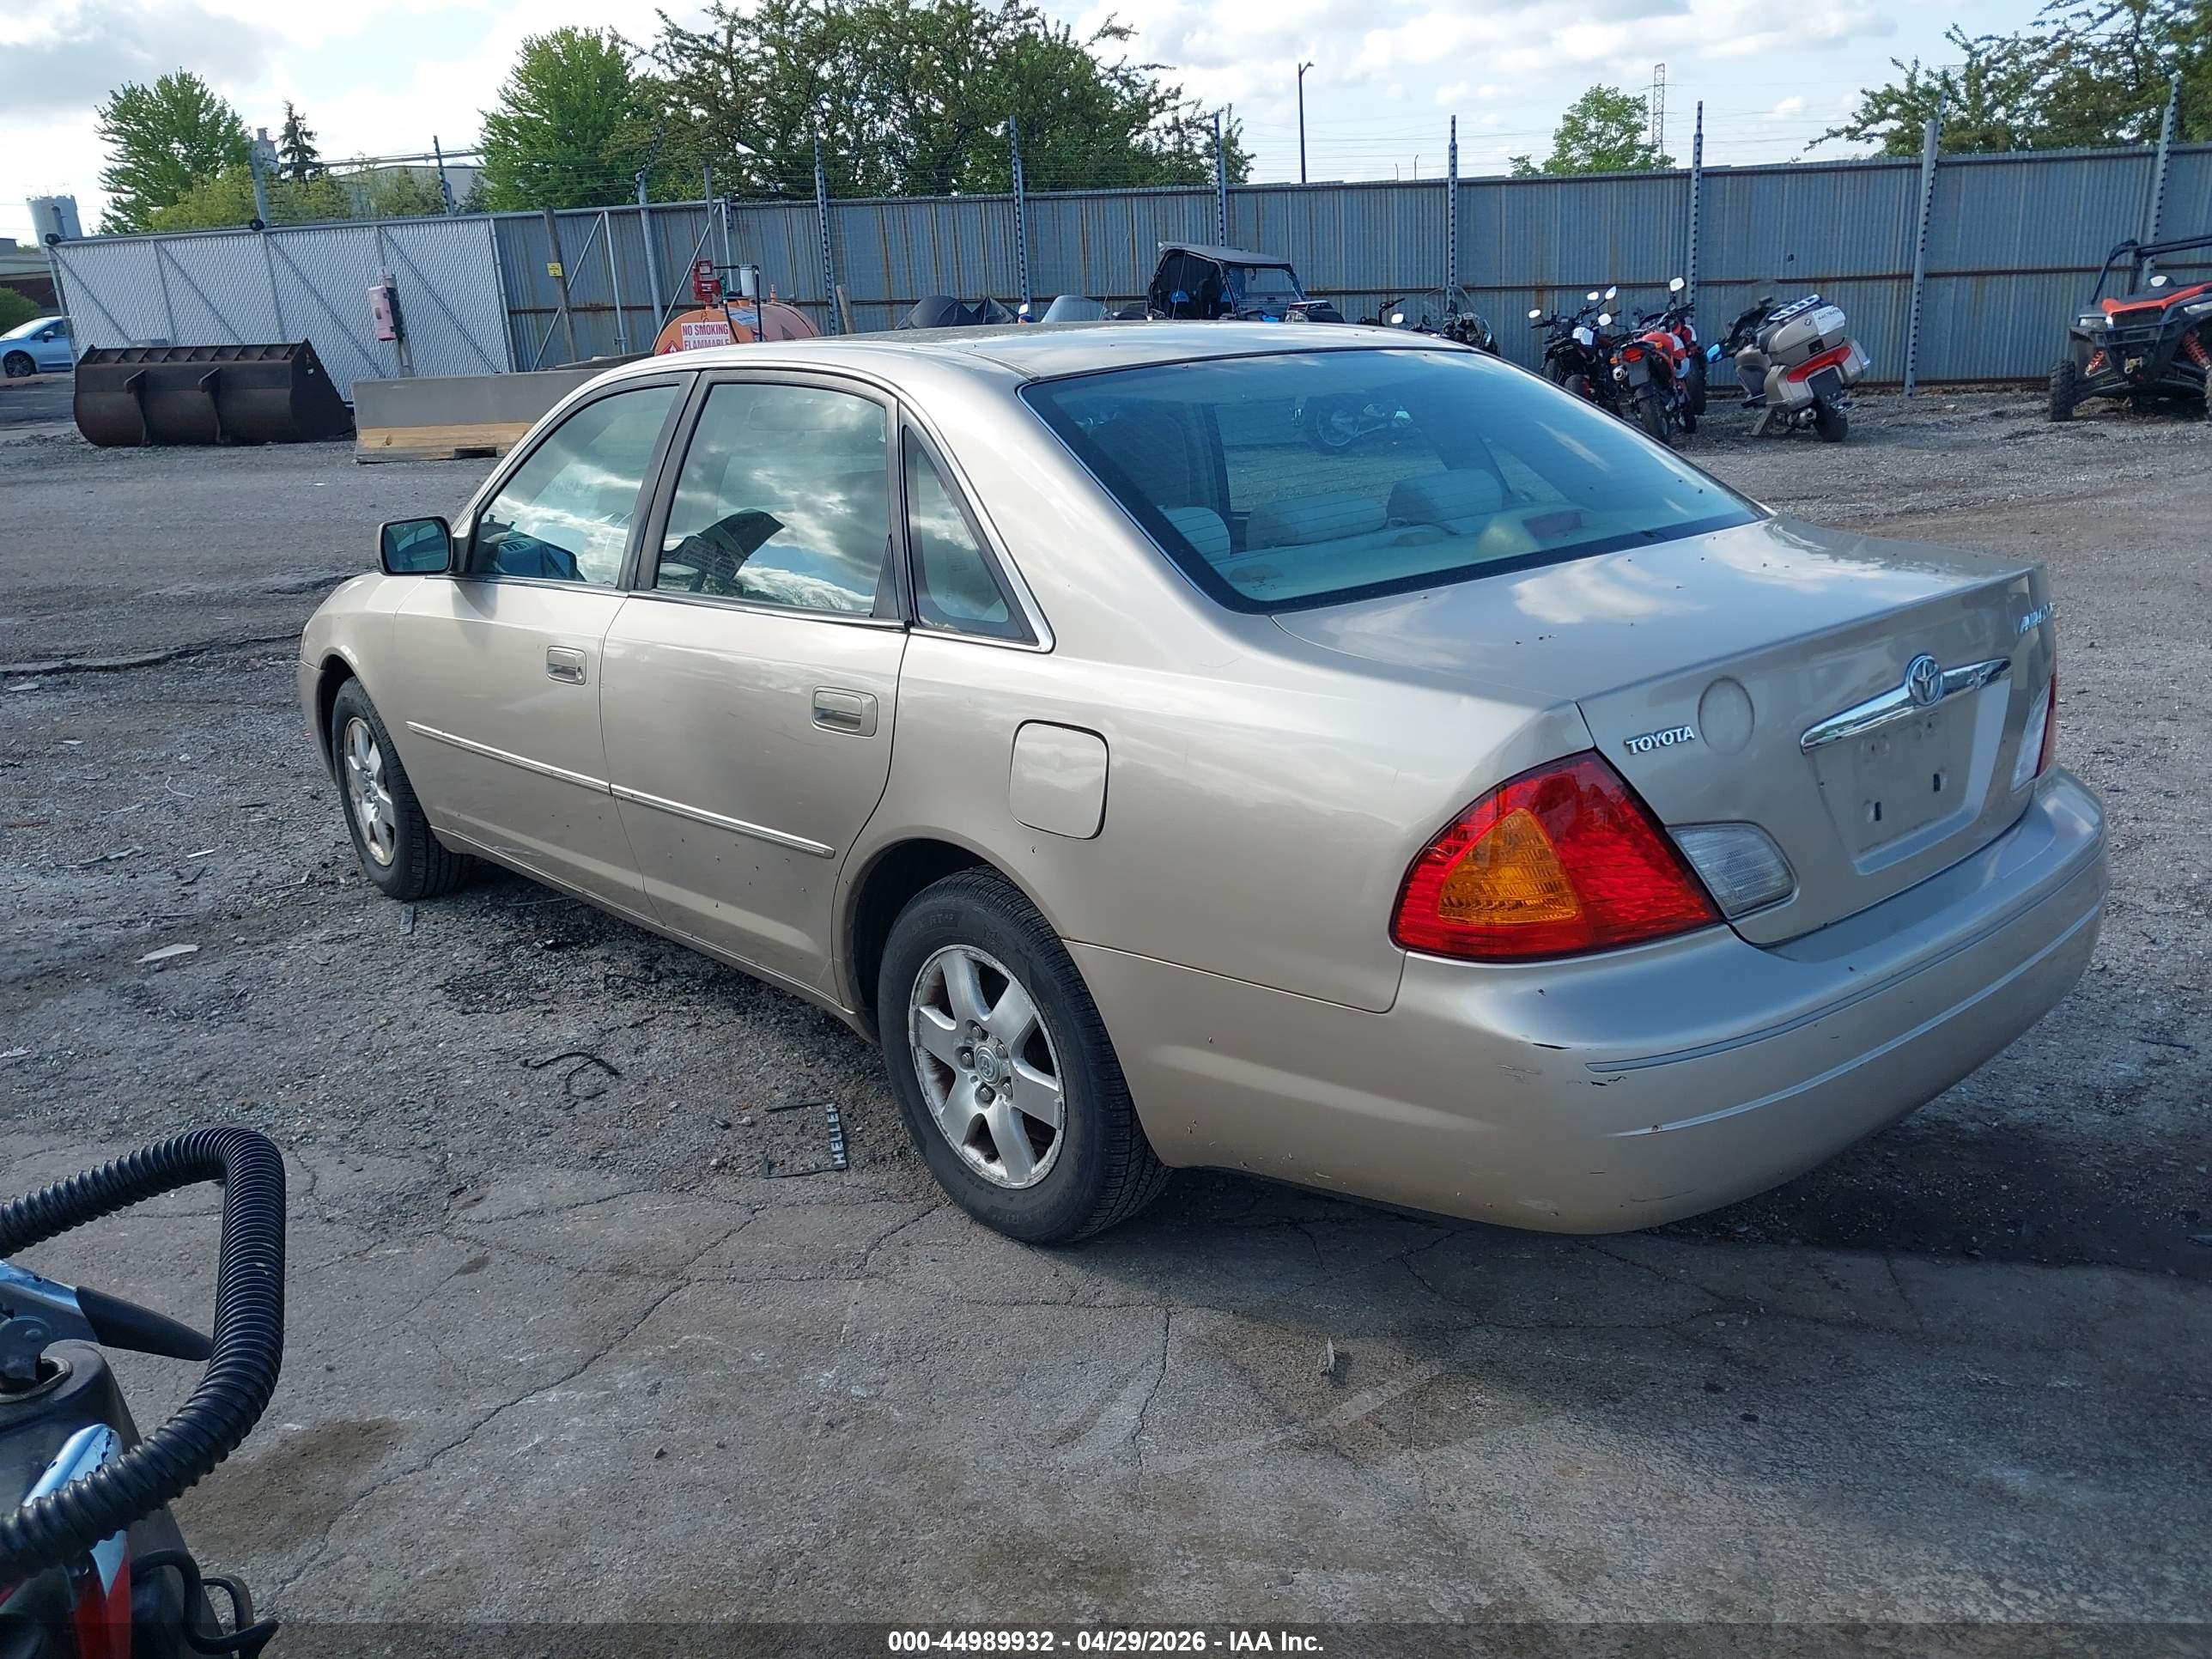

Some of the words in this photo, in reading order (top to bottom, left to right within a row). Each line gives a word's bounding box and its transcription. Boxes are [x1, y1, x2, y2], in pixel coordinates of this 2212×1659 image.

[683, 325, 693, 336] NO
[695, 324, 728, 336] SMOKING
[1625, 725, 1696, 755] TOYOTA
[825, 1103, 847, 1164] HELLER
